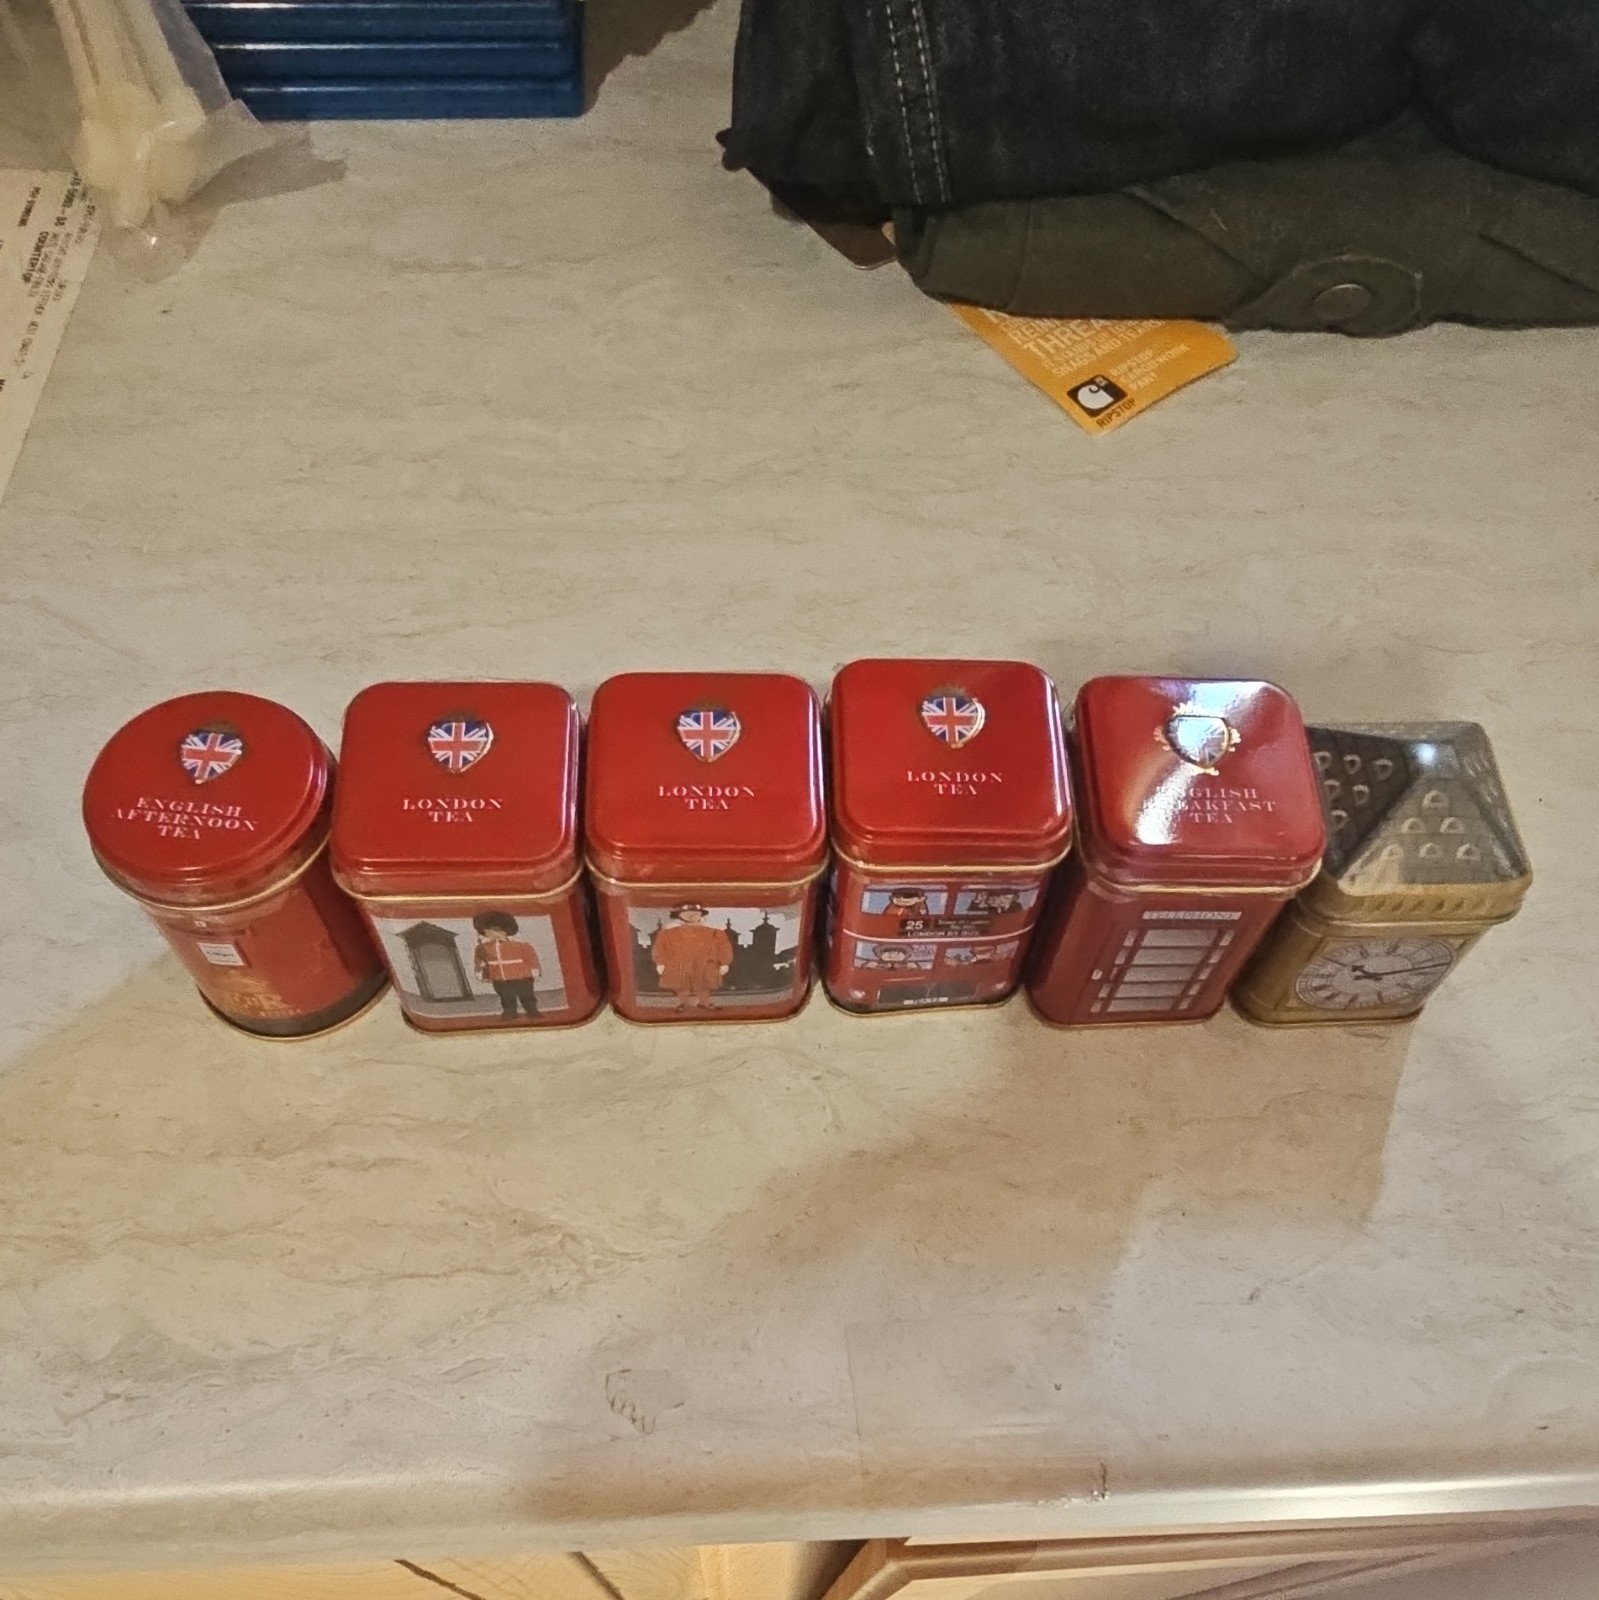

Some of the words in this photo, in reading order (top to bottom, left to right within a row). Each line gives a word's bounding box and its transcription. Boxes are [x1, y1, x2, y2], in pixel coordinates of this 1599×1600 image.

[1023, 319, 1113, 358] THREA
[1096, 397, 1135, 429] RIPSTOP
[907, 770, 1003, 783] LONDON
[658, 785, 755, 797] LONDON
[933, 783, 977, 795] TEA
[137, 797, 242, 818] ENGLISH
[403, 798, 502, 810] LONDON
[684, 798, 729, 810] TEA
[1142, 799, 1276, 812] EAKFAST
[111, 808, 257, 831] AFTERNOON
[428, 811, 473, 822] TEA
[1189, 812, 1233, 823] TEA
[158, 825, 200, 839] TEA
[905, 920, 924, 931] 25
